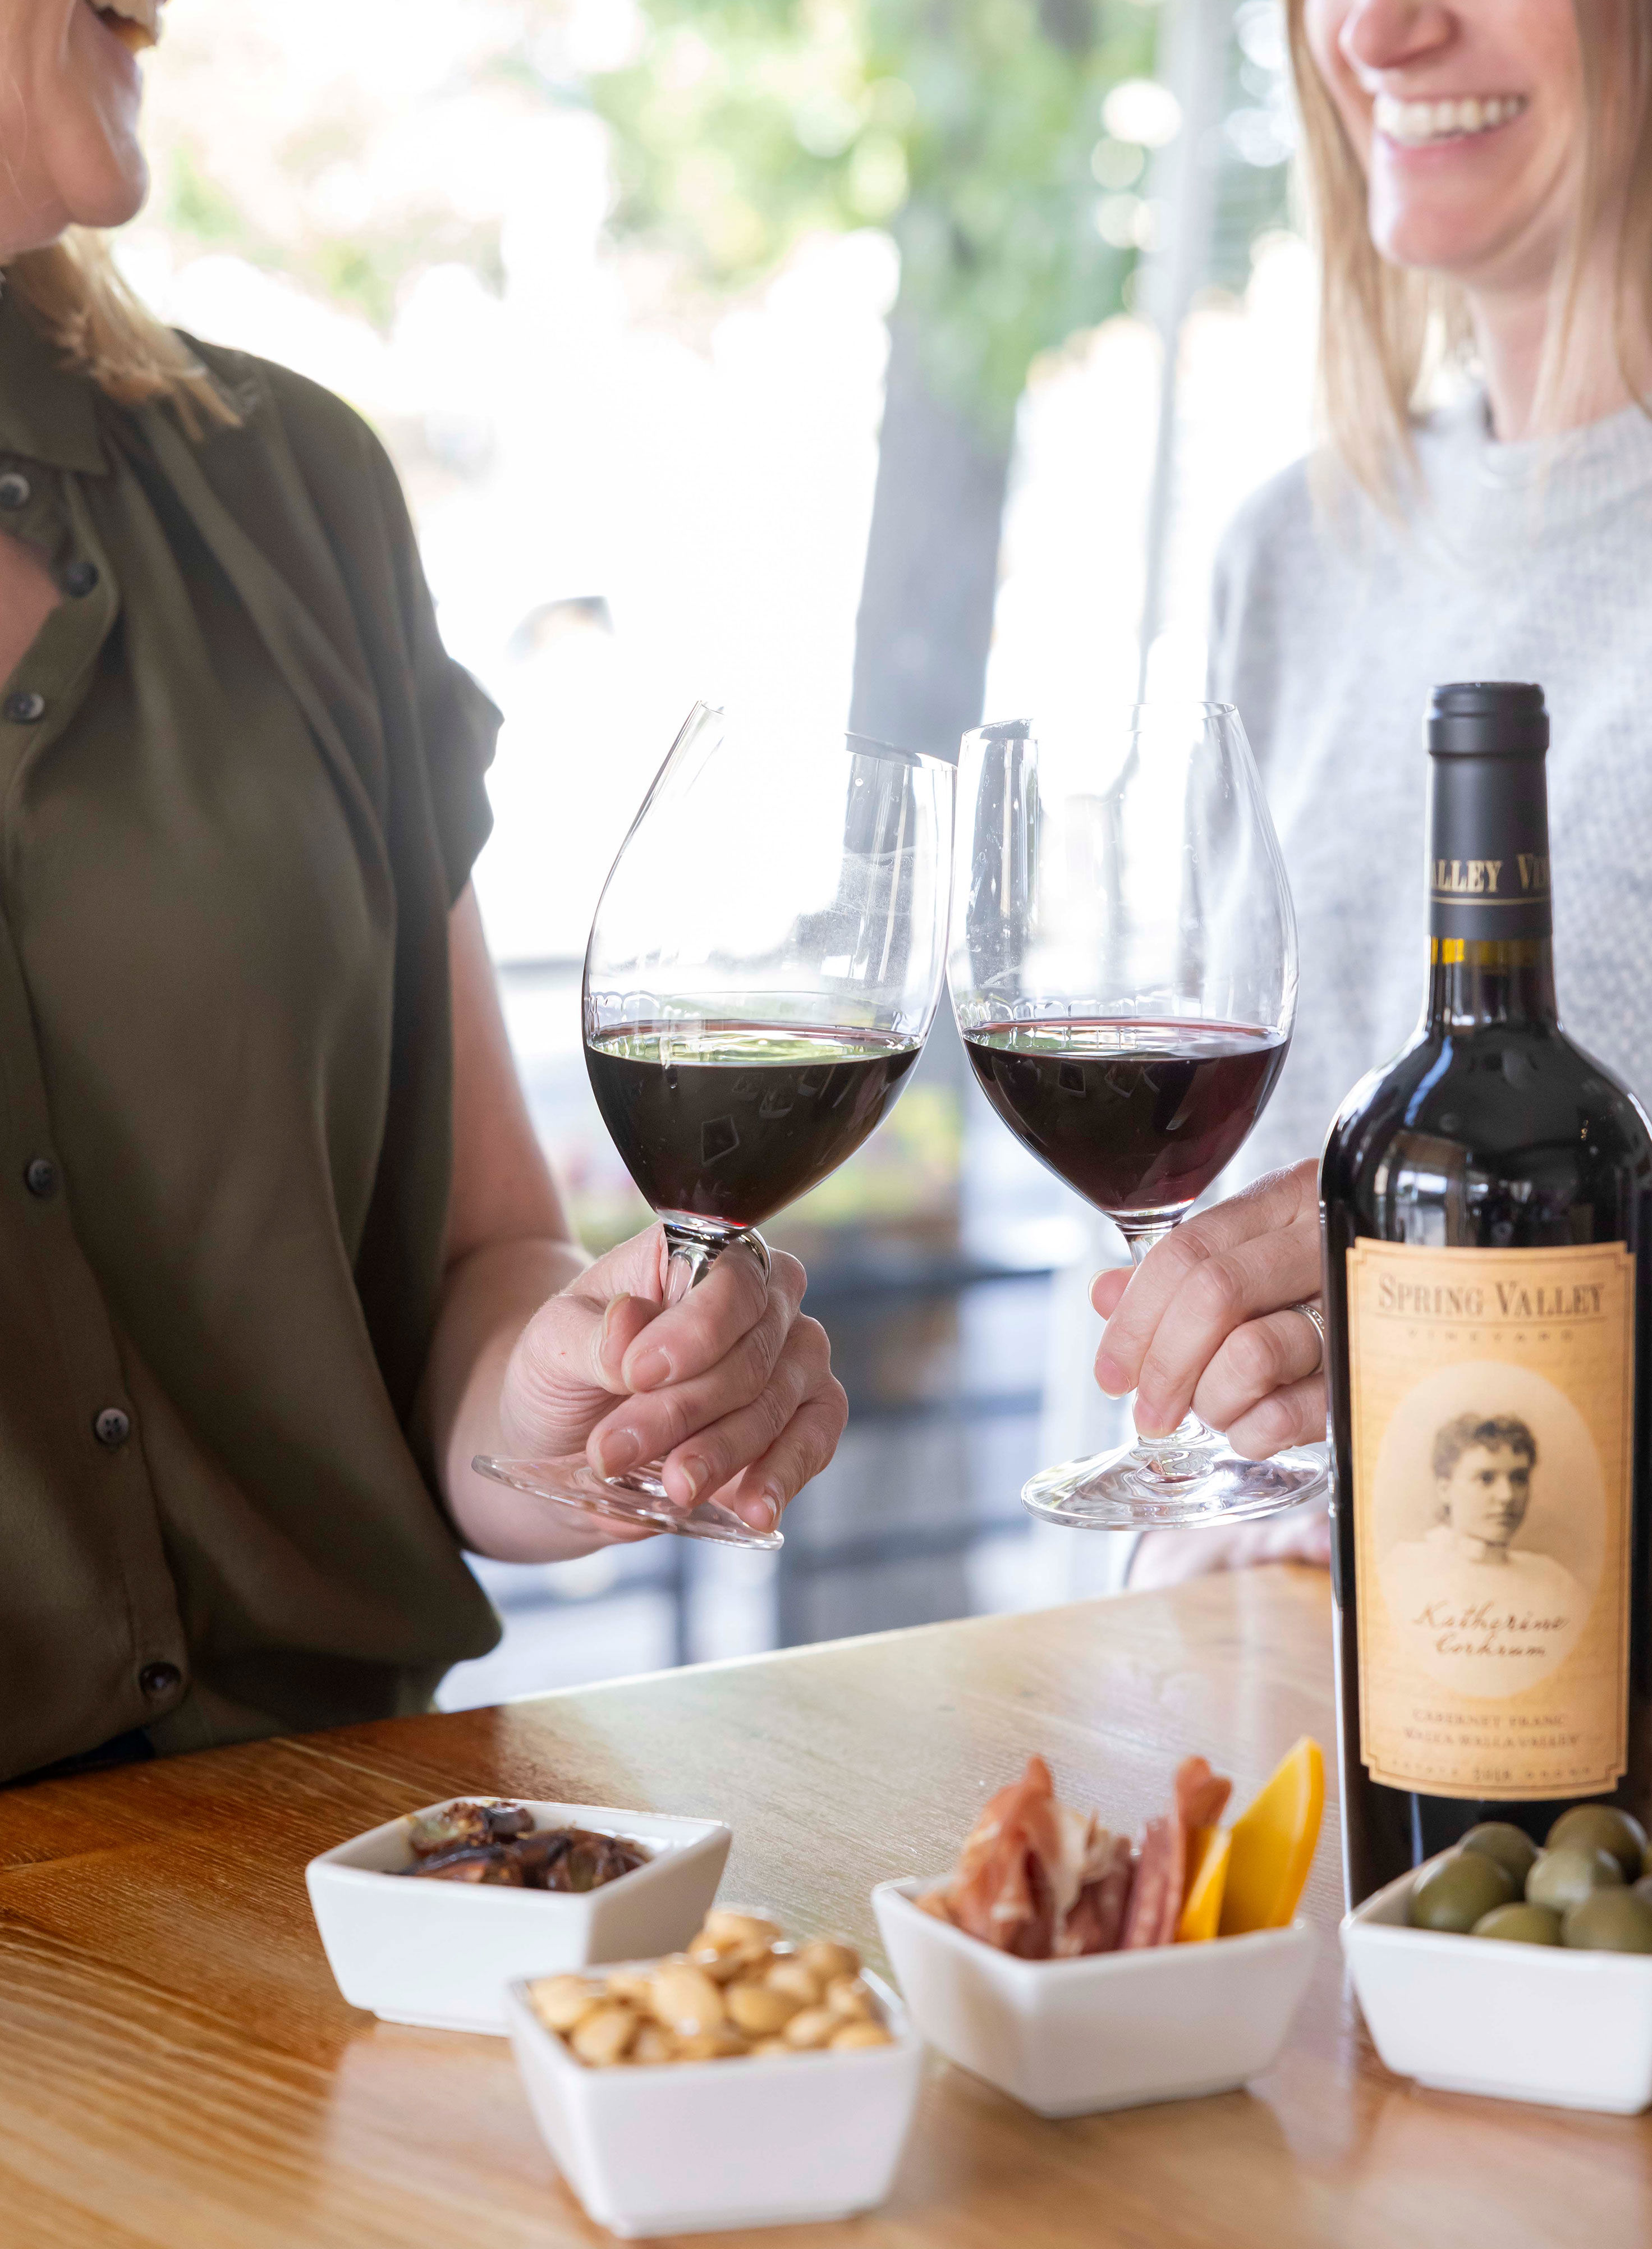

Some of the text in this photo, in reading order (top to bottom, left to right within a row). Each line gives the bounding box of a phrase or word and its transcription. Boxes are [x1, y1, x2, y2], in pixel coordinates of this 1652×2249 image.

[1432, 859, 1503, 893] LLEY
[1379, 1273, 1605, 1317] SPRING VALLEY
[1413, 1600, 1570, 1630] Katherine
[1414, 1709, 1564, 1728] CABERNET FRANC
